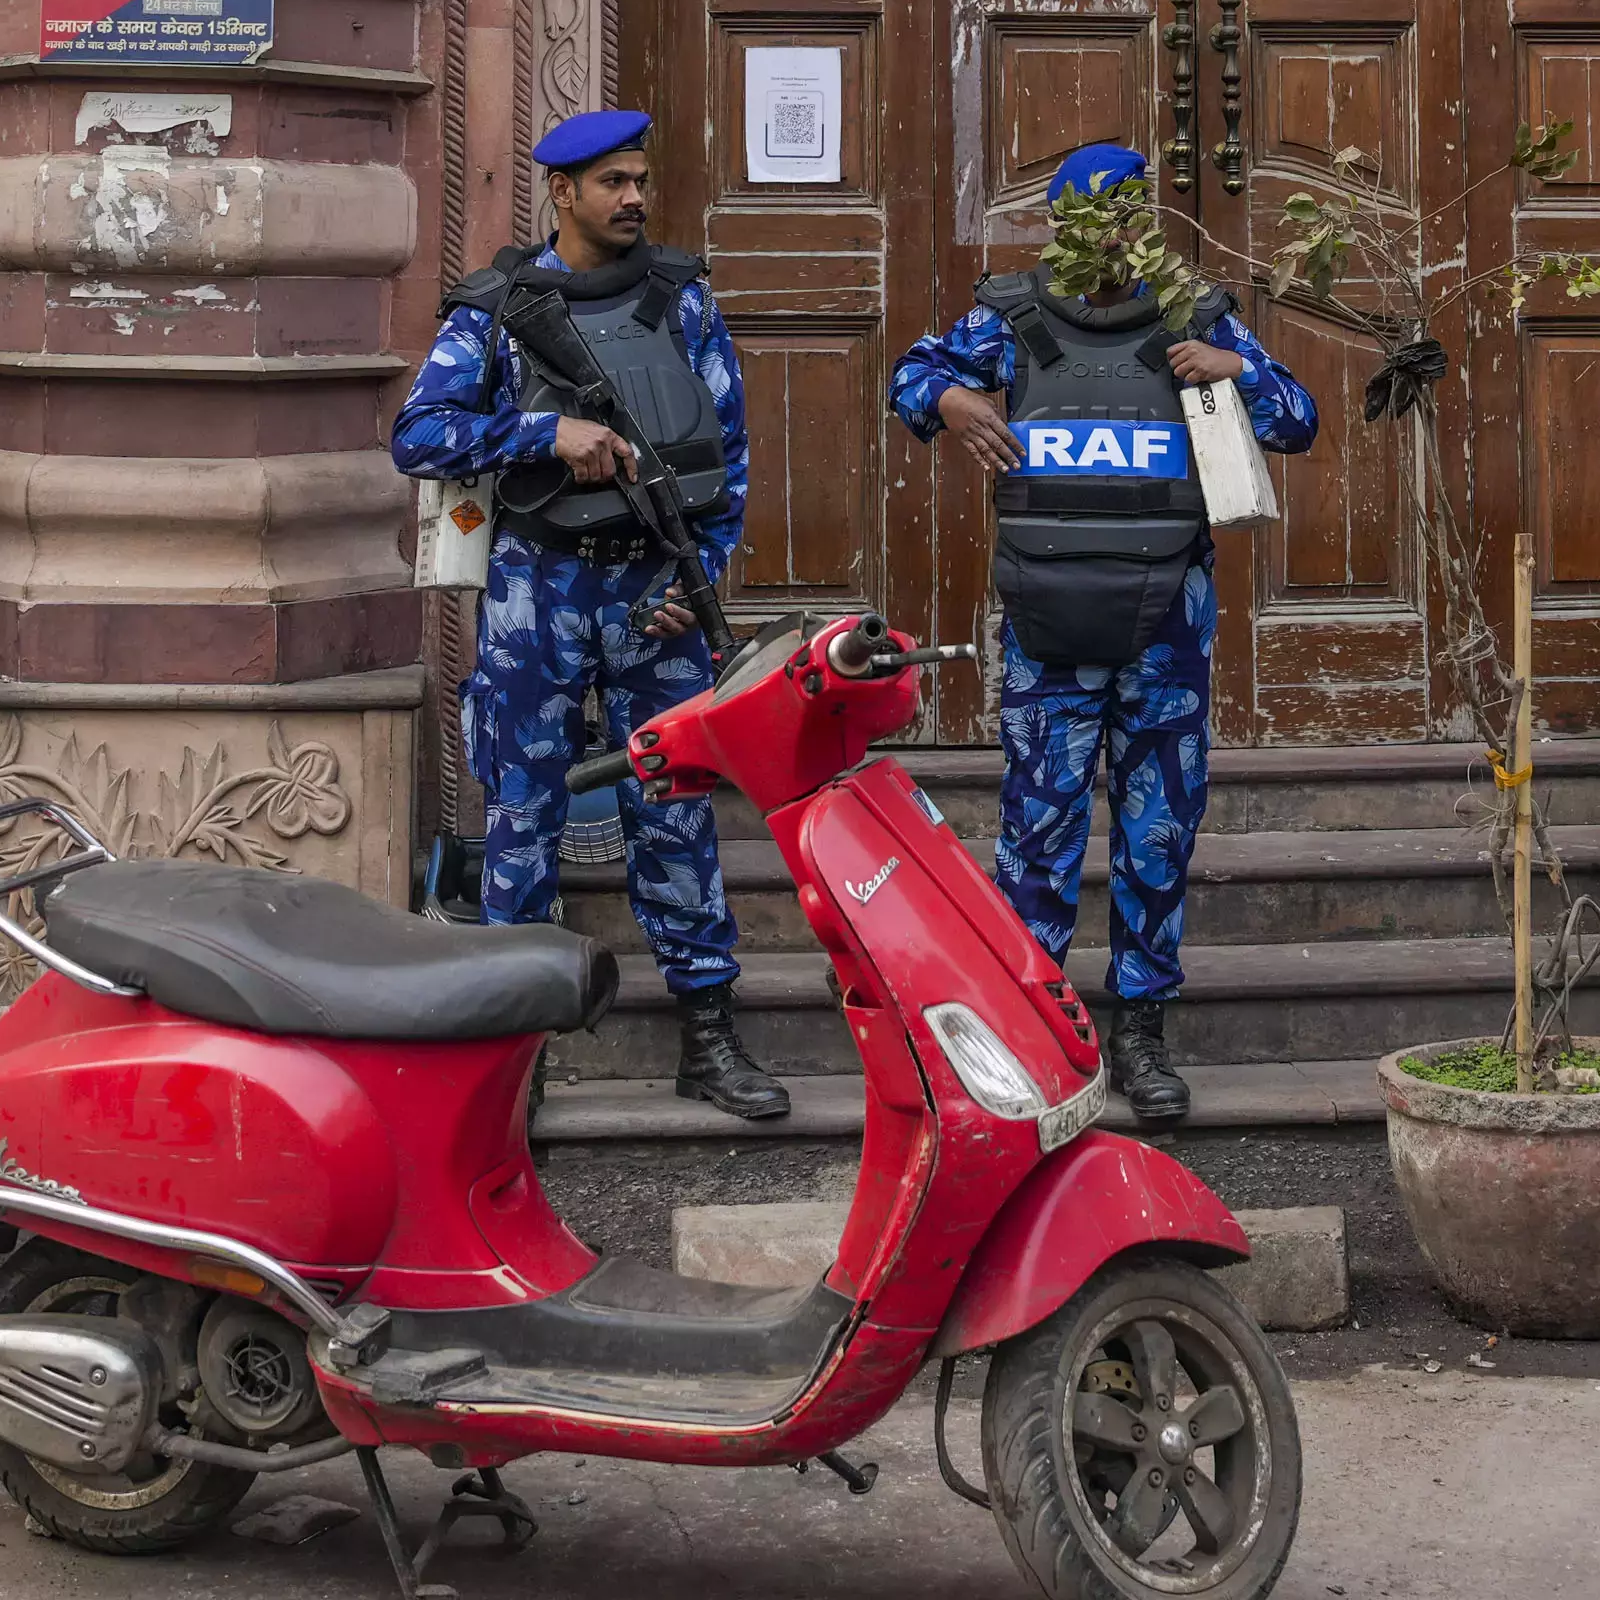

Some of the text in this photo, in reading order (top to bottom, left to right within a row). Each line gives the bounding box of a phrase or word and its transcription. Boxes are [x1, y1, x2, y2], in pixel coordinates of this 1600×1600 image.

[96, 16, 114, 34] के
[117, 20, 156, 36] समय
[161, 16, 202, 36] केवल
[1055, 361, 1145, 380] POLICE
[1029, 428, 1170, 469] RAF
